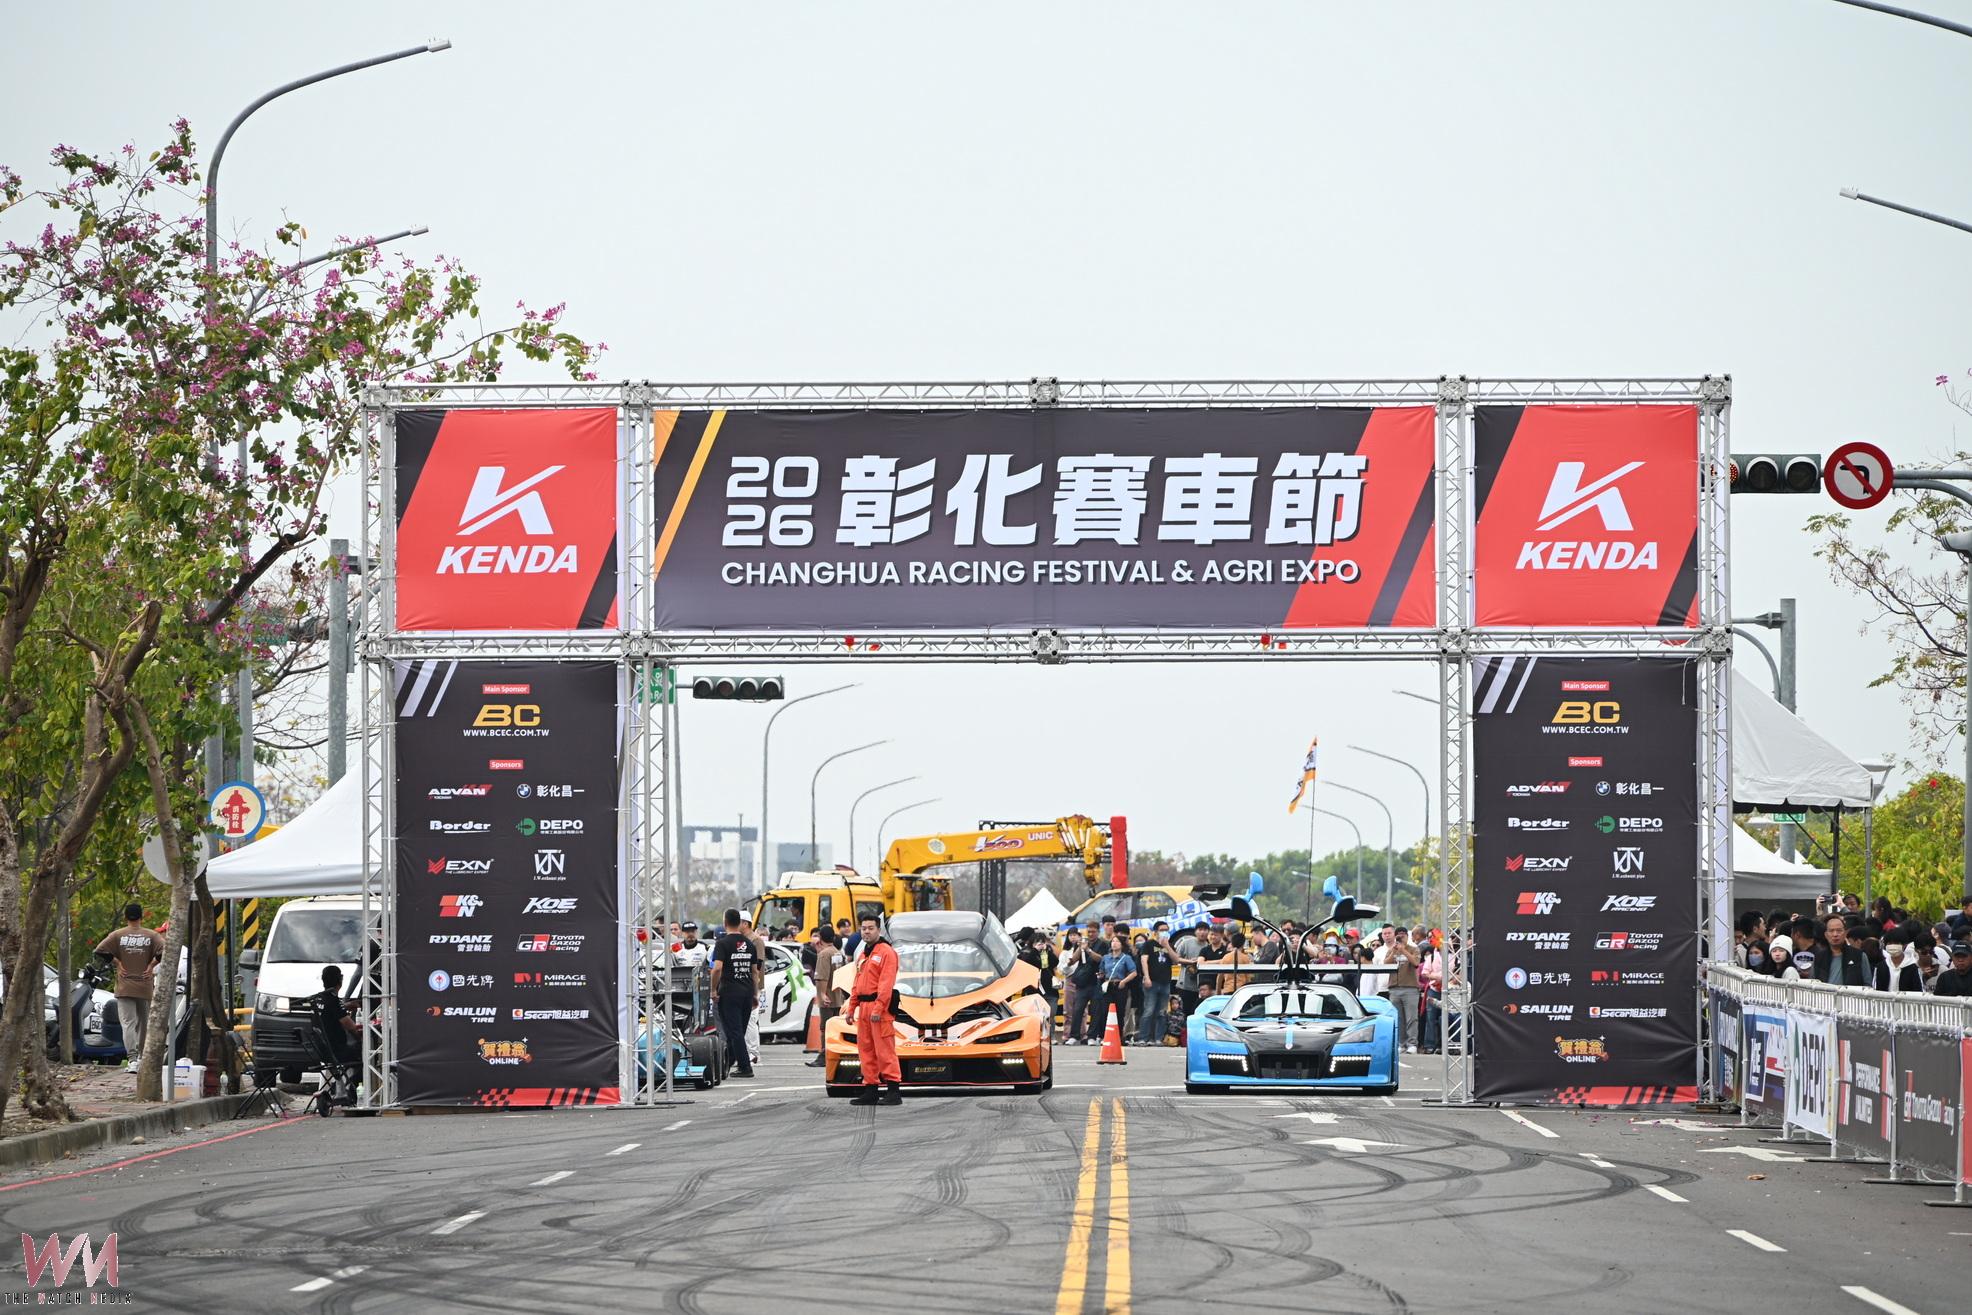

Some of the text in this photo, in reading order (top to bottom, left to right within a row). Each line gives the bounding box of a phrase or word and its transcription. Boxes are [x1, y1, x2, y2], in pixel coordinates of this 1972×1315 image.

[727, 456, 819, 498] 20
[836, 452, 1369, 548] 彰化賽車節
[722, 504, 814, 546] 26
[436, 545, 577, 574] KENDA
[1515, 541, 1657, 569] KENDA
[722, 559, 1359, 585] CHANGHUA RACING FESTIVAL & AGRI EXPO
[501, 686, 527, 694] Sponsor
[1581, 683, 1607, 691] Sponsor
[472, 704, 540, 727] BC
[1551, 701, 1620, 723] BC
[463, 729, 549, 737] WWW.BCEC.COM.TW
[1542, 726, 1629, 734] WWW.BCEC.COM.TW
[537, 785, 584, 797] 彰化昌一
[1616, 783, 1664, 795] 彰化昌一
[430, 821, 491, 830] Border
[540, 820, 583, 830] DEPO
[1508, 818, 1569, 828] Border
[1619, 818, 1662, 827] DEPO
[1028, 832, 1054, 841] UNIC
[430, 935, 493, 943] RYDANZ
[1506, 933, 1571, 941] RYDANZ
[518, 941, 548, 951] GR
[1597, 939, 1625, 948] GR
[444, 1007, 497, 1016] SAILUN
[1520, 1005, 1573, 1014] SAILUN
[1802, 1031, 1826, 1118] DEPO
